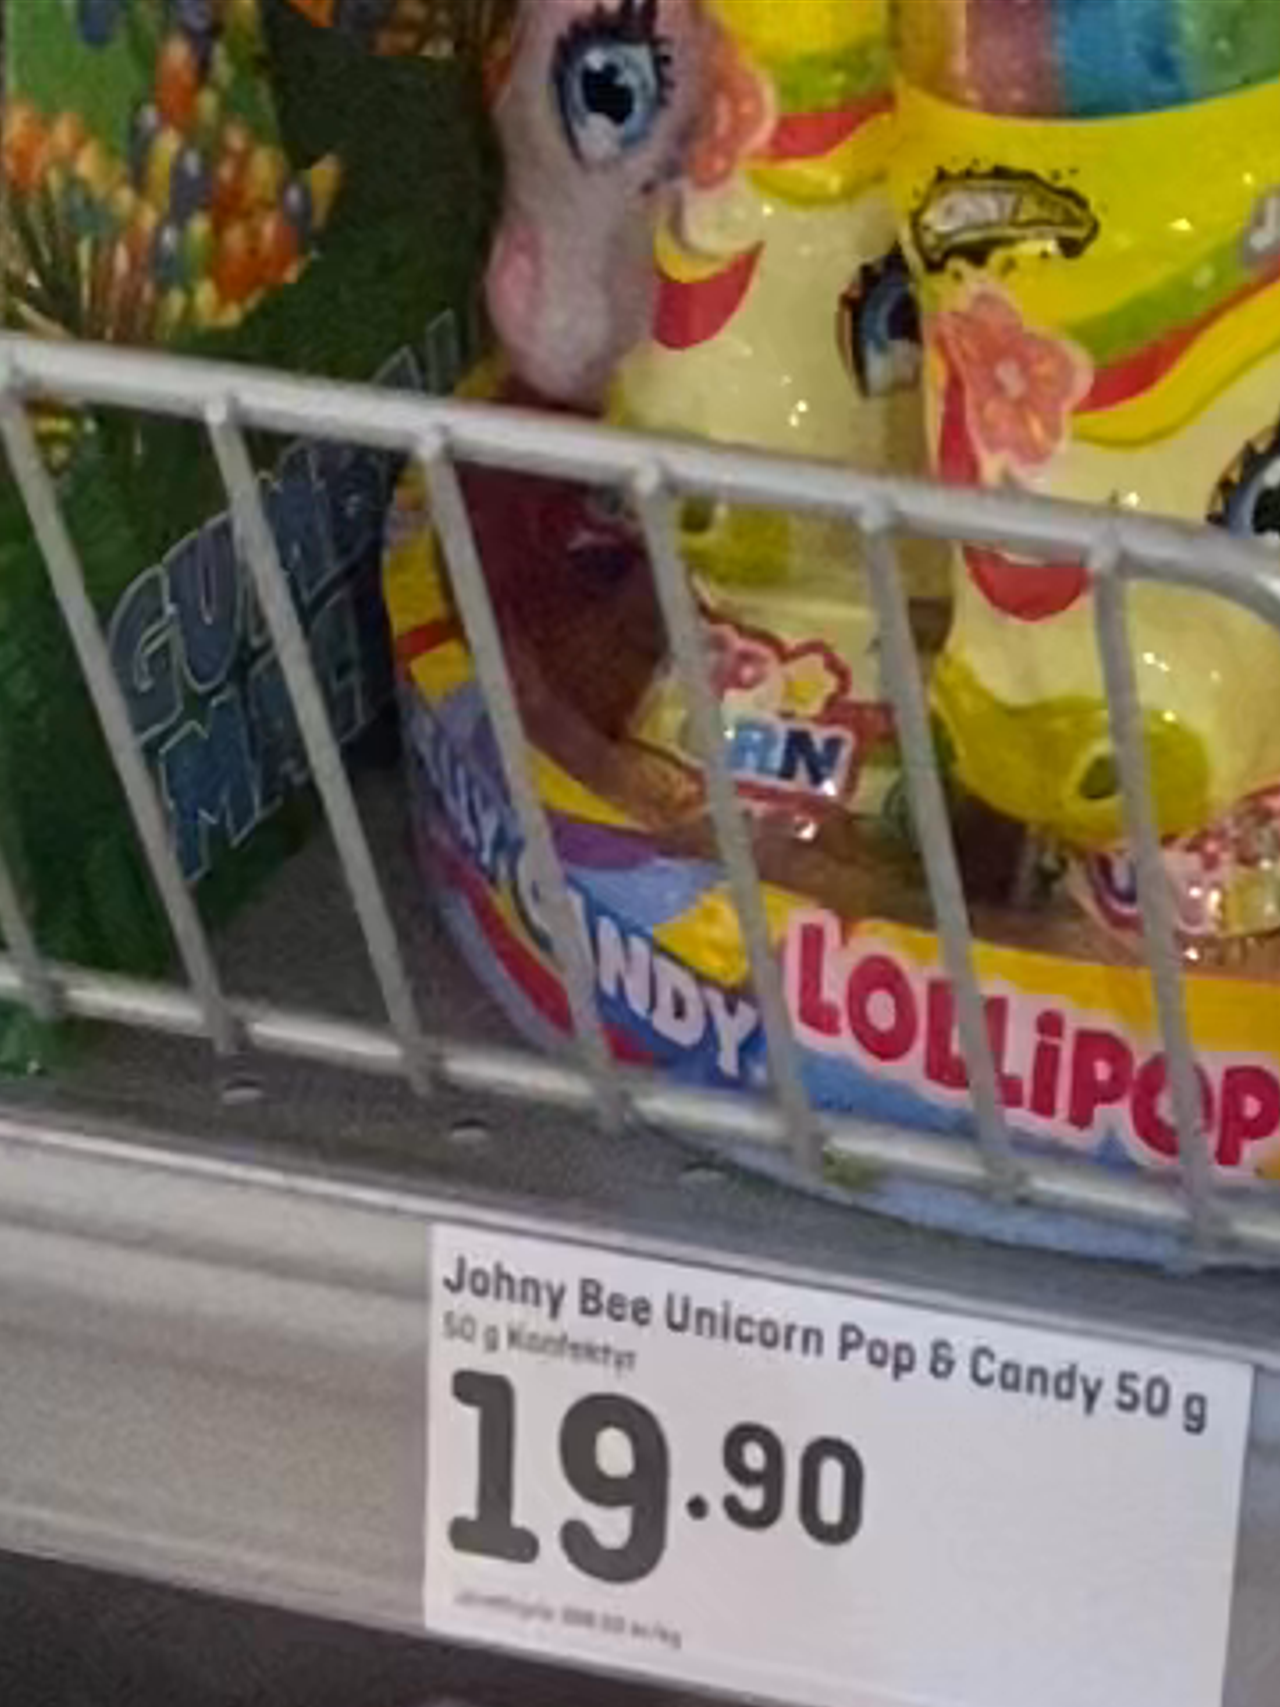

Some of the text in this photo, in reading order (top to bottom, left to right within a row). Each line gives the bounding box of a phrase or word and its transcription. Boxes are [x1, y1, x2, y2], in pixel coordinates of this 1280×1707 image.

[443, 1256, 1208, 1434] Johny Bee Unicorn Pop & Candy 50 g
[449, 1369, 864, 1585] 19.90
